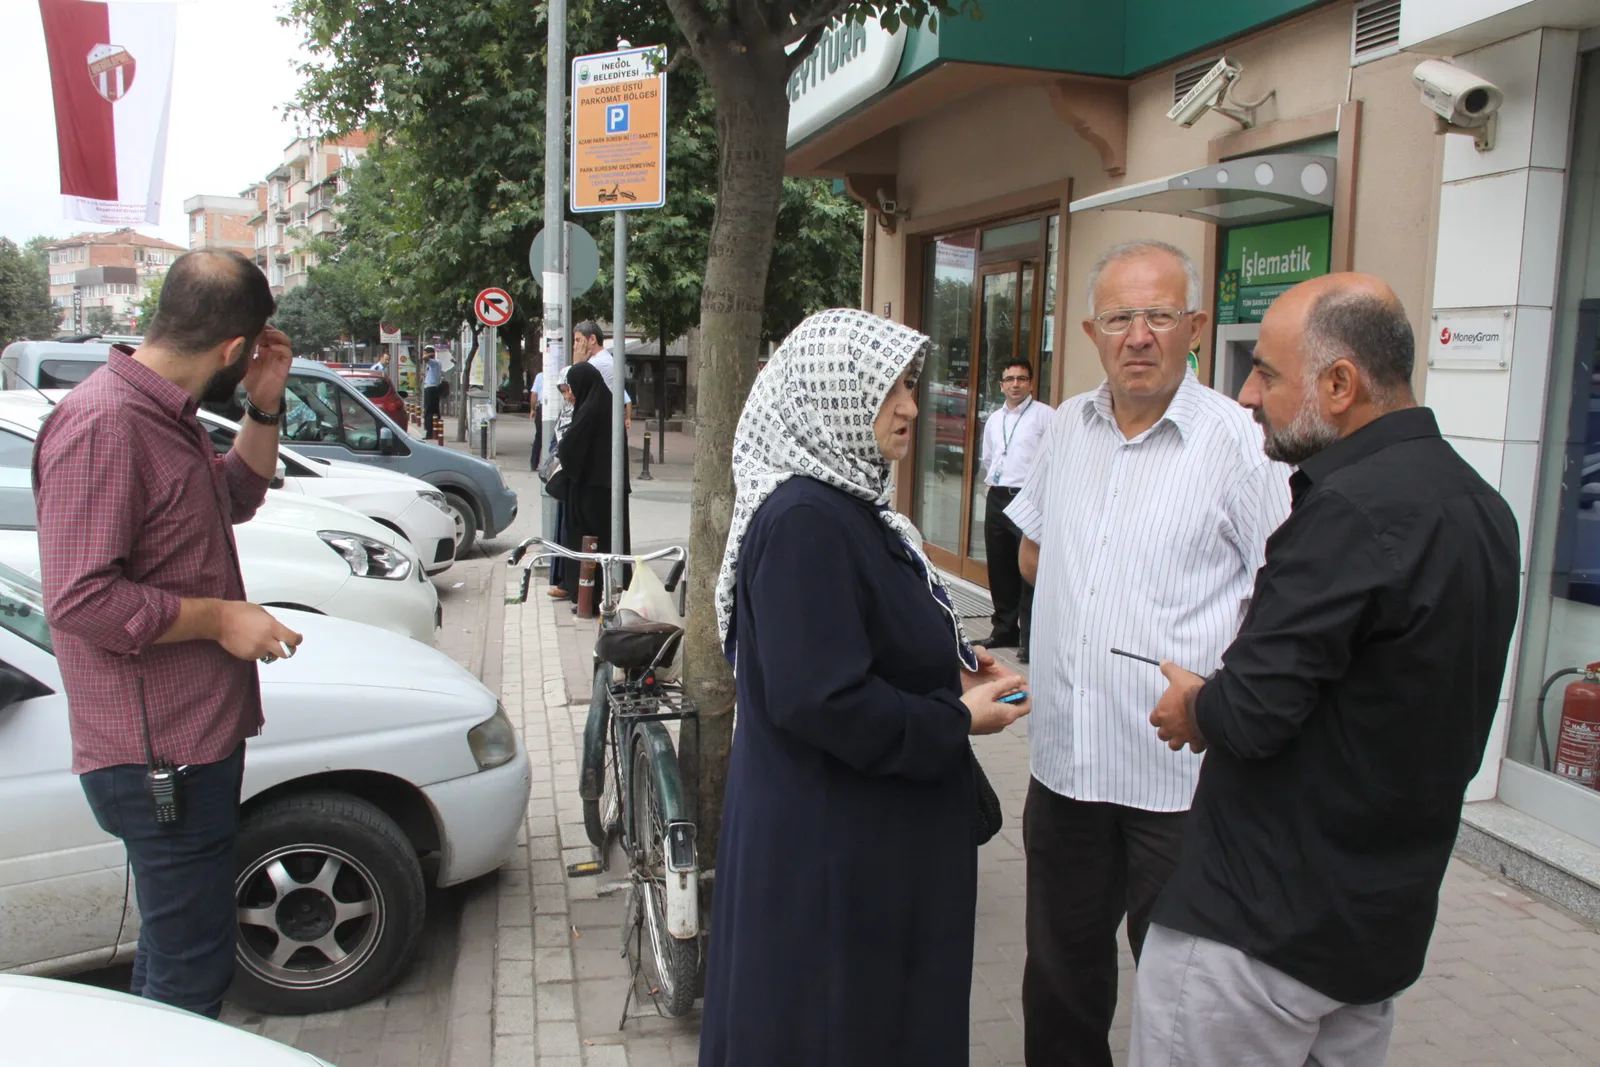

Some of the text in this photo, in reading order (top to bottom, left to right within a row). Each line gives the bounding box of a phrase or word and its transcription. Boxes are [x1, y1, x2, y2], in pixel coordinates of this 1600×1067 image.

[601, 60, 631, 71] İNEGÖL
[593, 68, 639, 81] BELEDİYESİ
[595, 82, 643, 95] CADDE ÜSTÜ
[581, 88, 658, 106] PARKOMAT BÖLGESİ
[610, 108, 625, 130] P
[1241, 245, 1311, 283] İşlematik
[1453, 332, 1499, 344] MoneyGram
